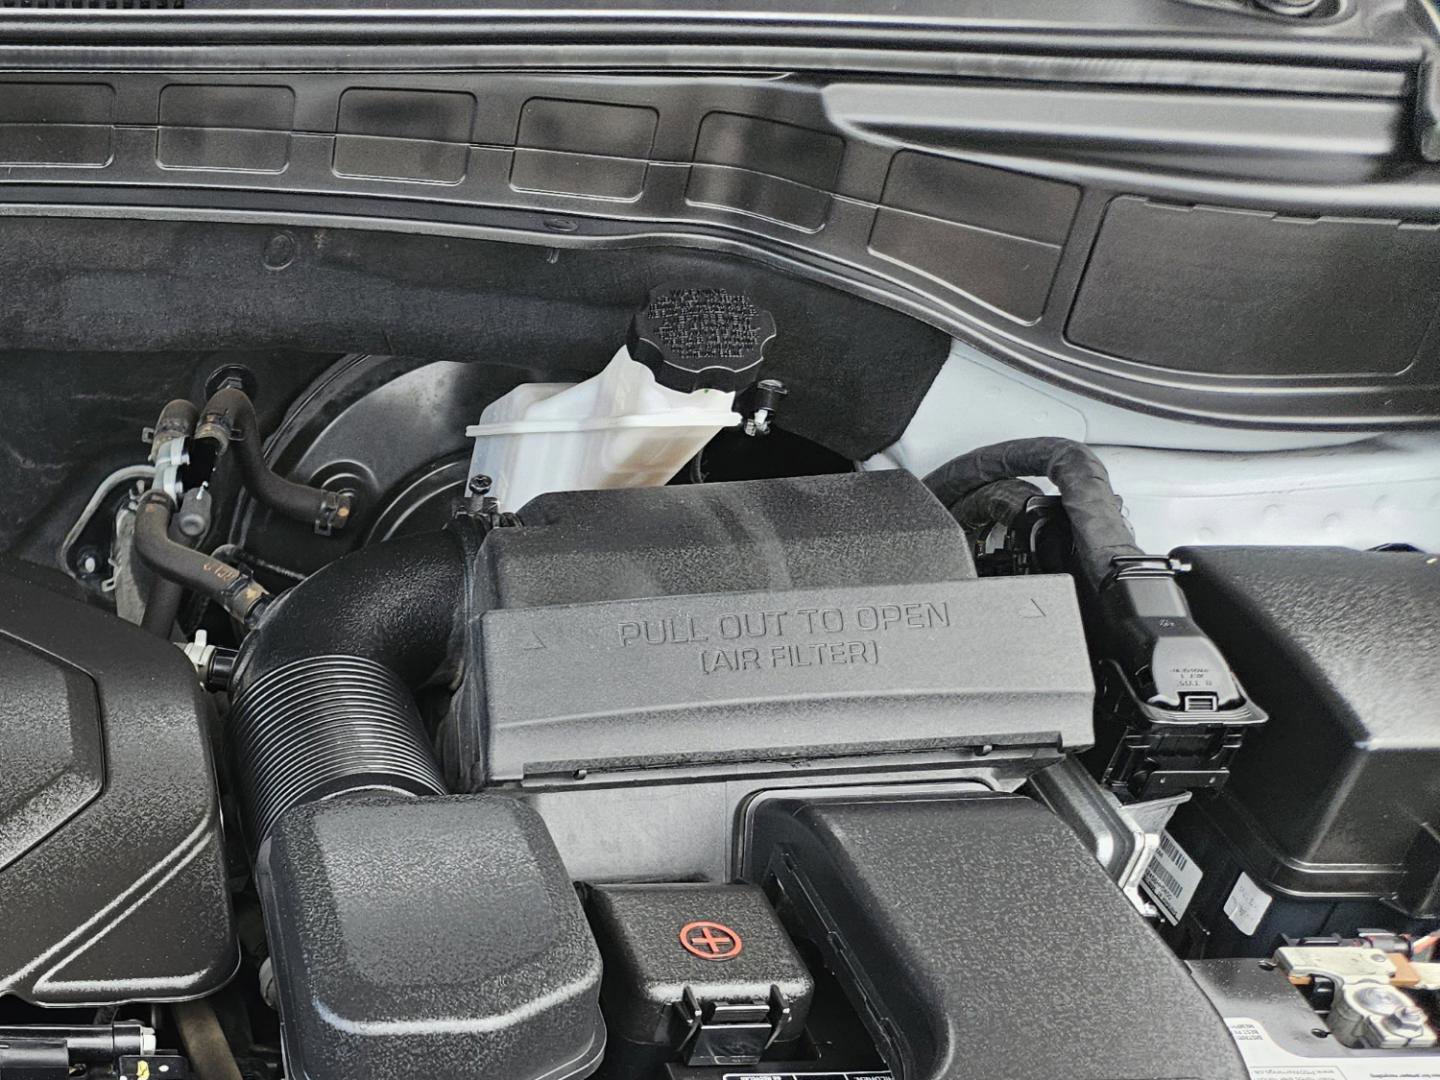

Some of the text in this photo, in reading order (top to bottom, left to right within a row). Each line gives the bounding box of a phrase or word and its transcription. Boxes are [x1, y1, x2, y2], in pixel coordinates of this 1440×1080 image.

[618, 601, 951, 647] PULL OUT TO OPEN
